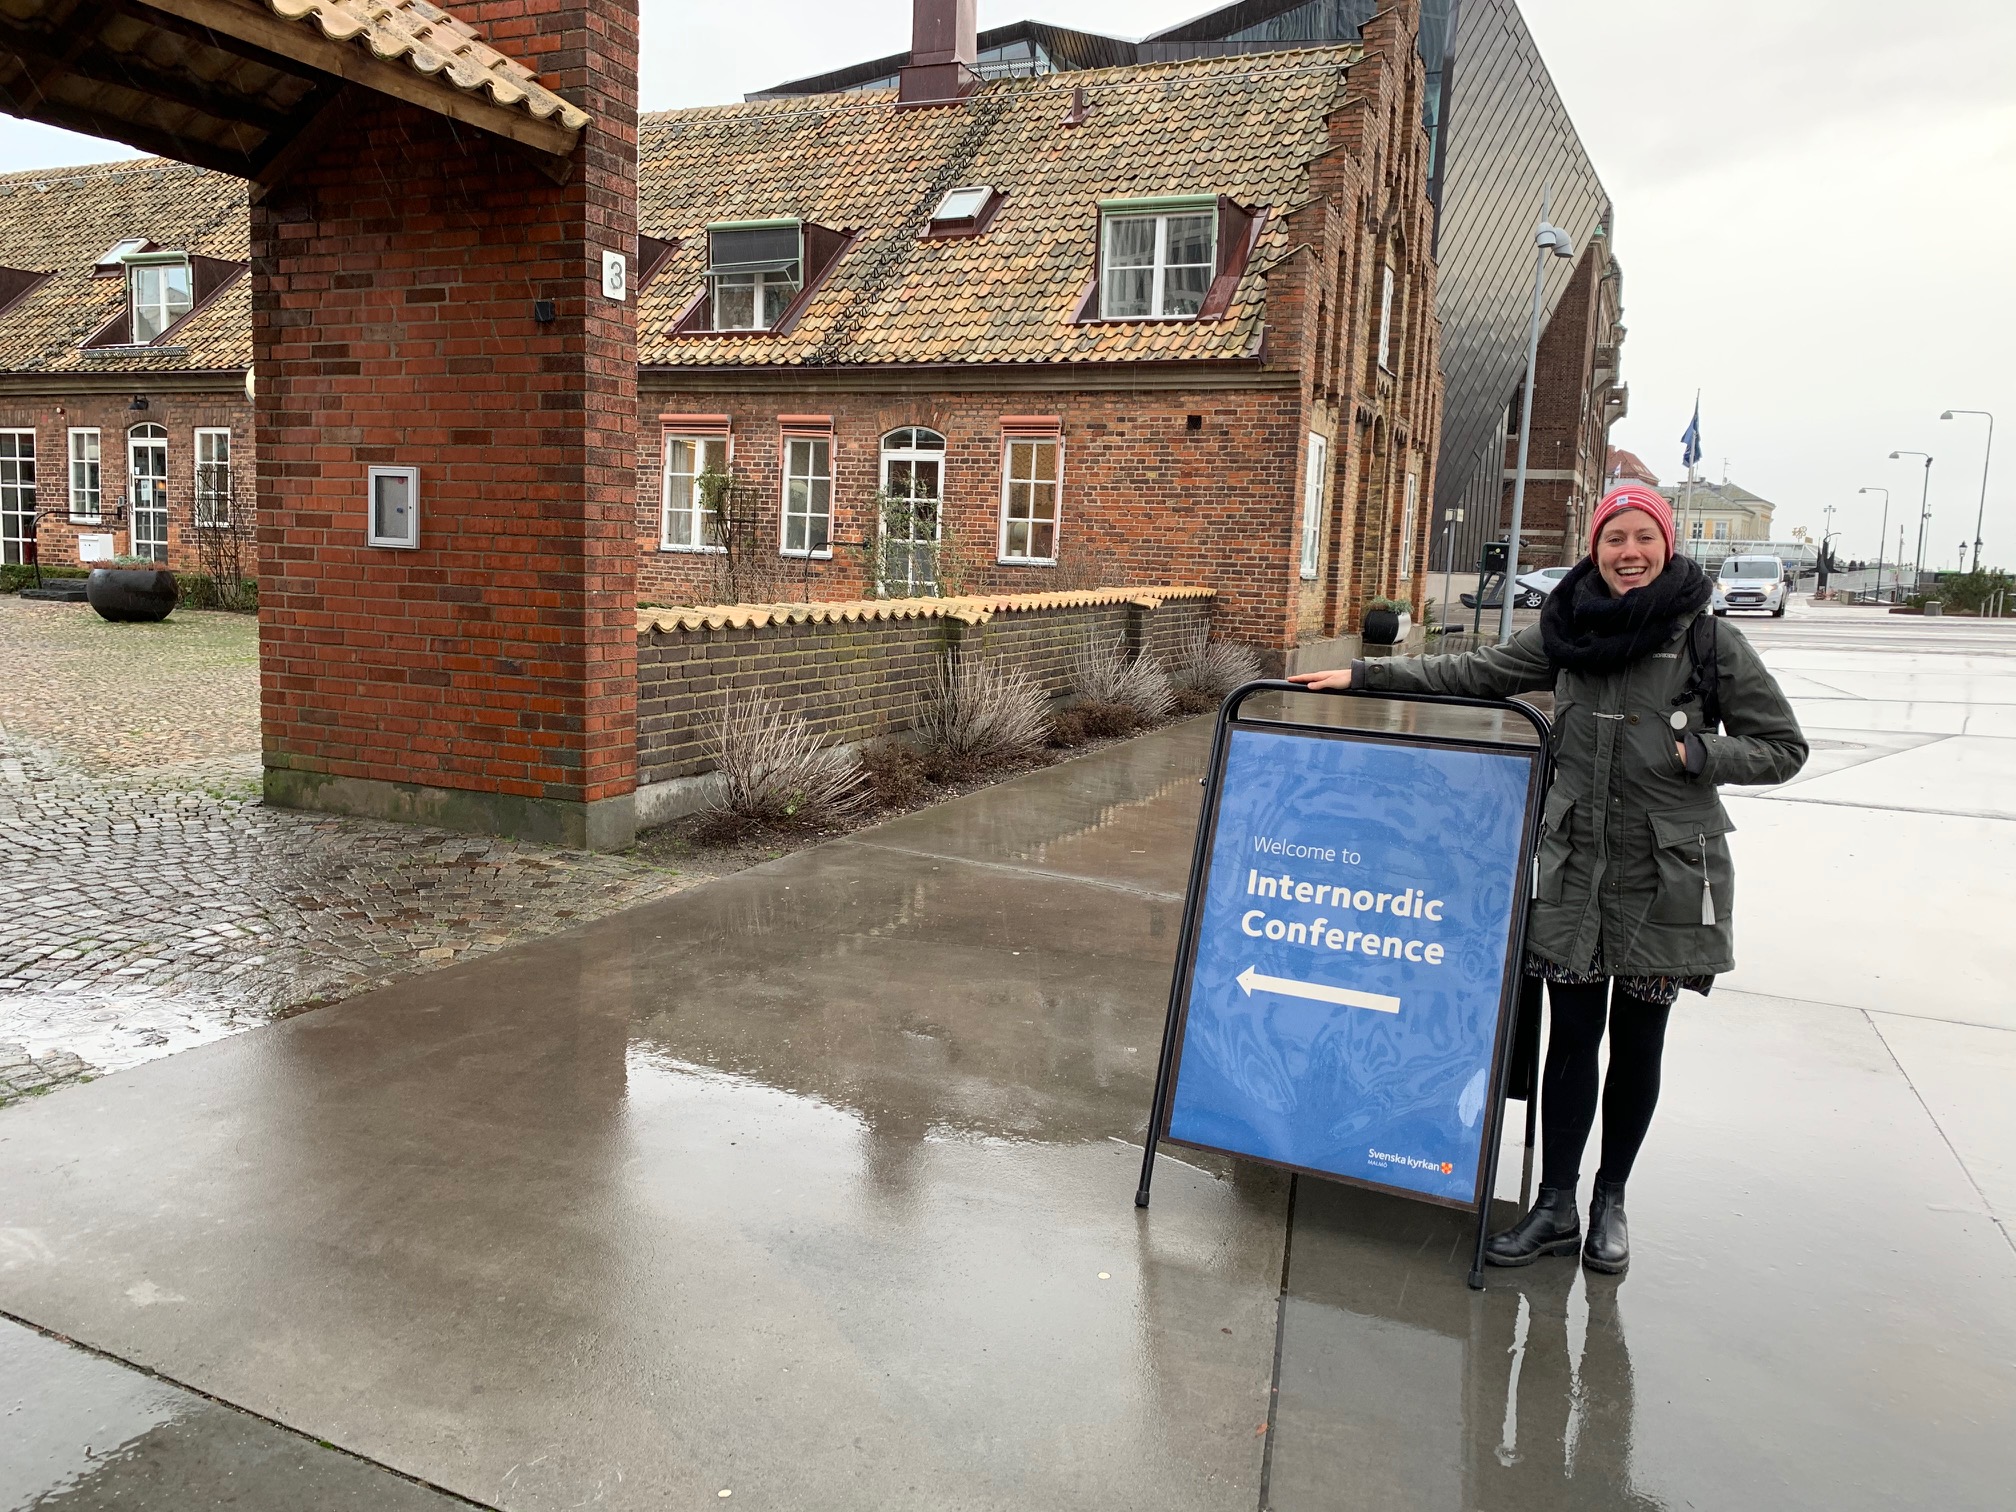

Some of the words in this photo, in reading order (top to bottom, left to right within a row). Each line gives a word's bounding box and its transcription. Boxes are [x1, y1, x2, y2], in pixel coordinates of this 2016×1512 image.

[610, 260, 623, 290] 3
[1254, 835, 1335, 862] Welcome
[1341, 848, 1361, 865] to
[1247, 869, 1444, 921] Internordic
[1241, 910, 1445, 965] Conference
[1368, 1148, 1406, 1165] Svenska
[1407, 1155, 1440, 1172] kyrkan
